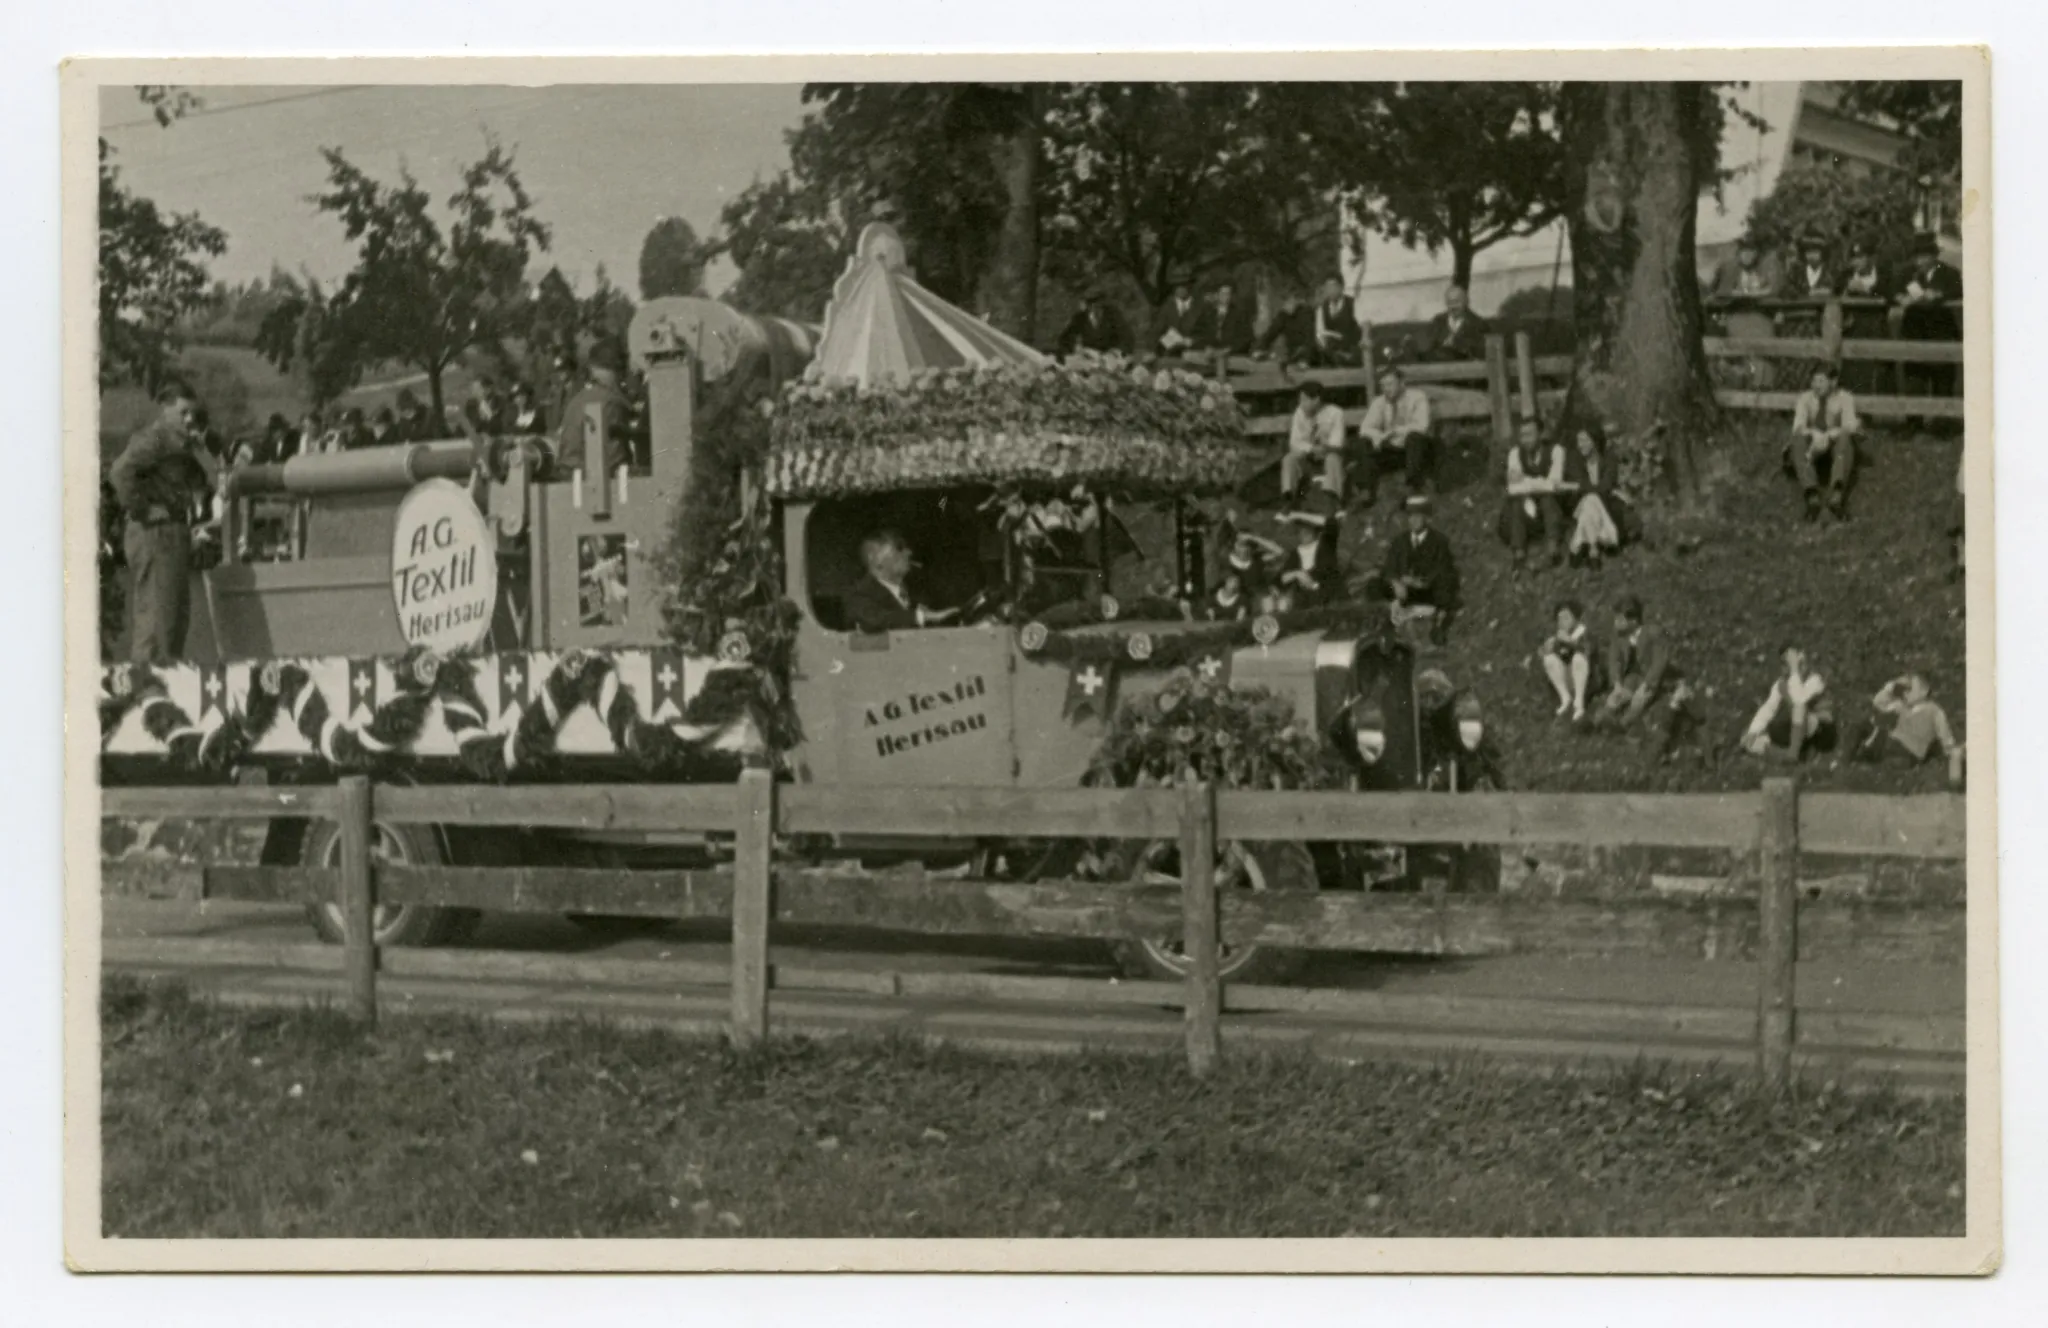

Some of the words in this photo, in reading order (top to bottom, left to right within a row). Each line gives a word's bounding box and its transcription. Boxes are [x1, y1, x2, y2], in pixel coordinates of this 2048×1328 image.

[395, 545, 476, 608] Textil
[409, 599, 486, 640] Herisau
[909, 675, 985, 714] Textil
[876, 713, 987, 758] Herisau
